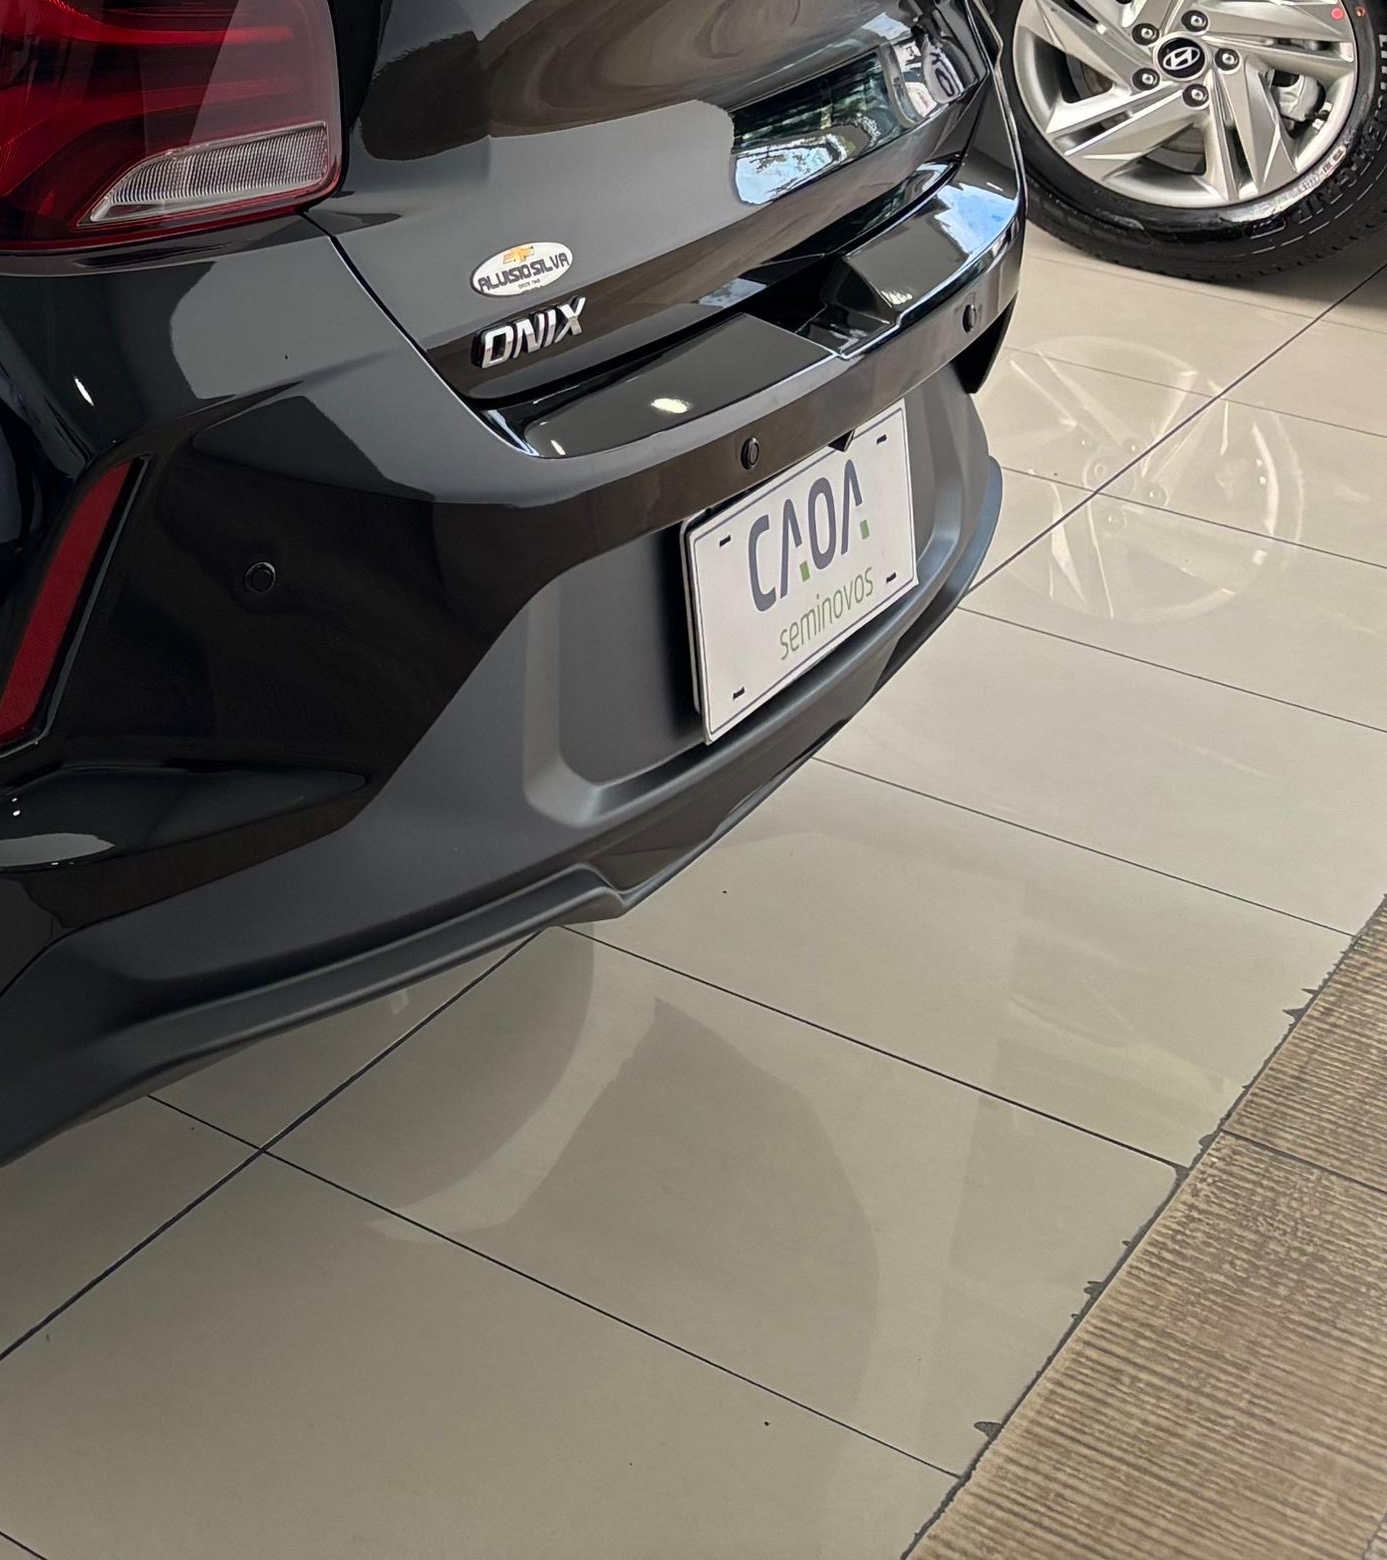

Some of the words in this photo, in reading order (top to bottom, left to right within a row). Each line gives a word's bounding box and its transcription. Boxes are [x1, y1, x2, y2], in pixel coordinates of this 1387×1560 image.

[481, 296, 586, 369] ONIX
[748, 458, 870, 612] CAOA
[779, 566, 874, 660] seminovos
